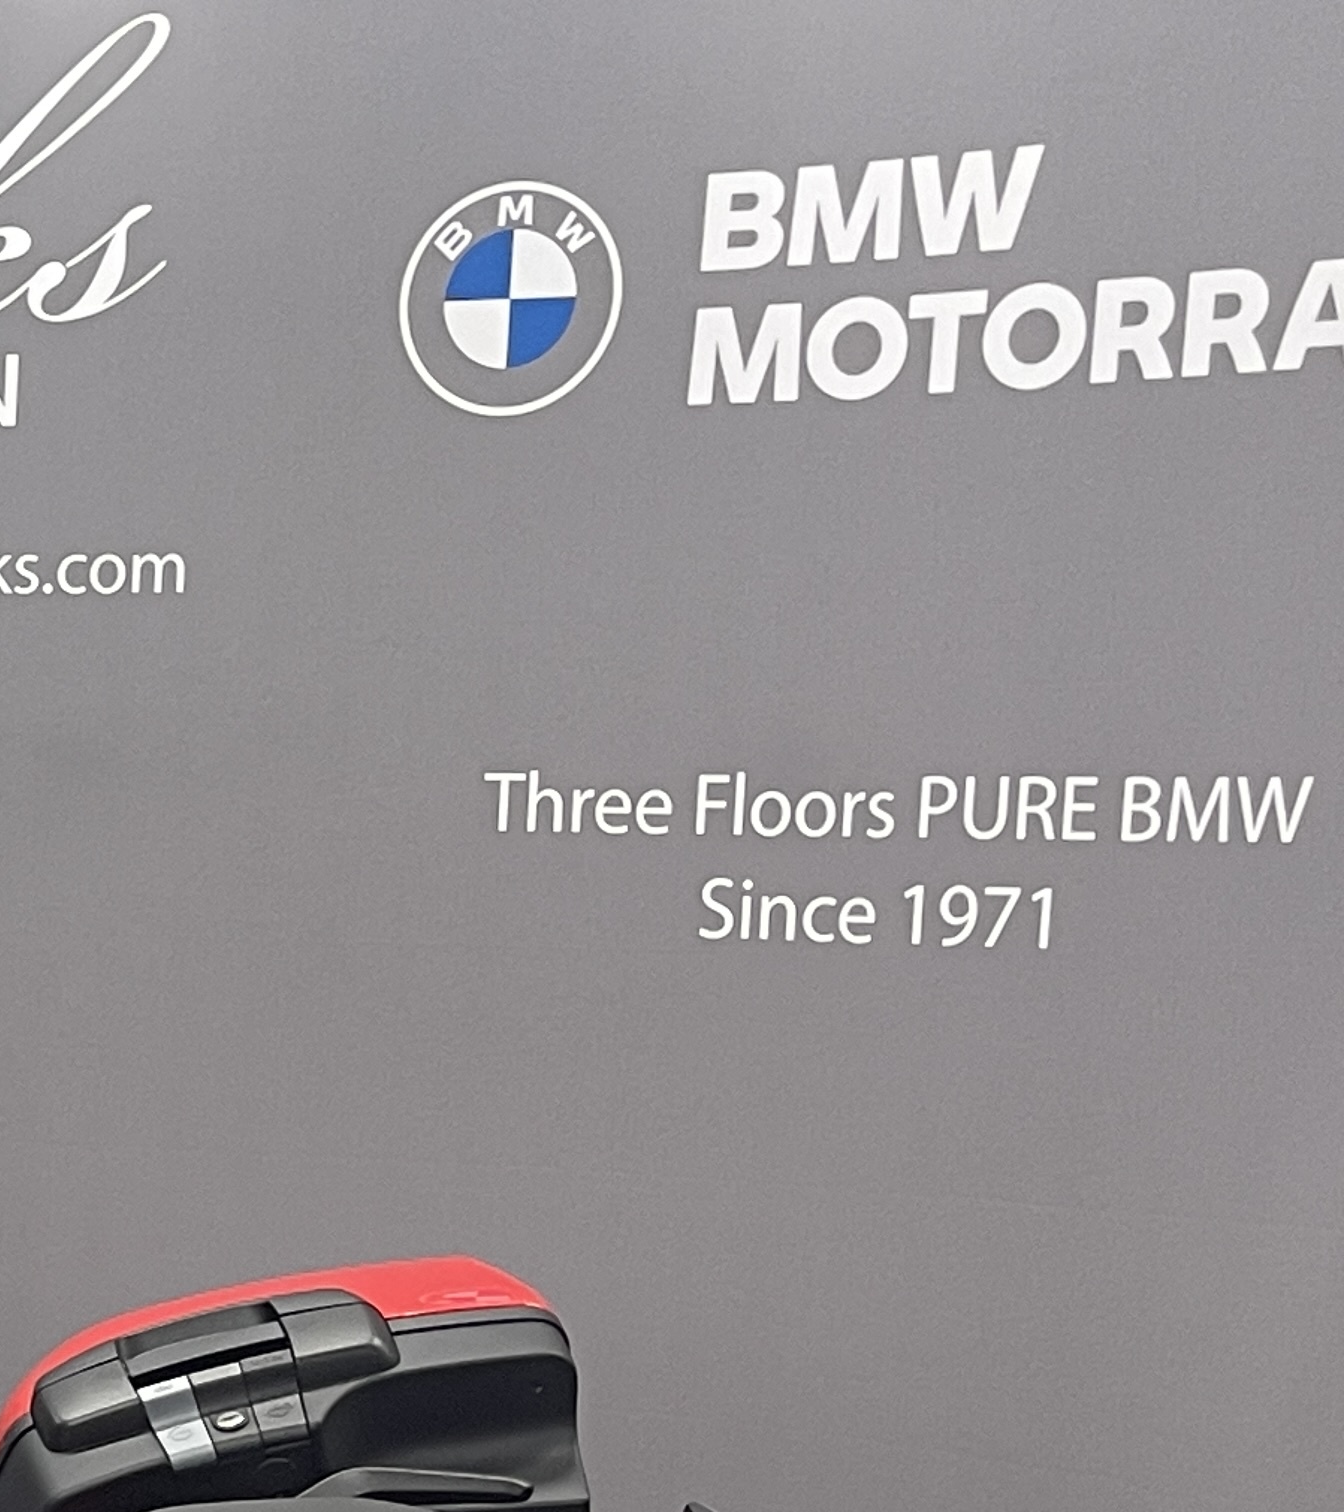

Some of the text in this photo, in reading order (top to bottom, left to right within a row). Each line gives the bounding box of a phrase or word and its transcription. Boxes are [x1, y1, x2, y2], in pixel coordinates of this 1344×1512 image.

[432, 193, 597, 263] BMW
[699, 142, 1047, 273] BMW
[686, 257, 1344, 407] MOTORRA
[482, 768, 1316, 844] Three Floors PURE BMW
[697, 876, 1054, 951] Since 1971
